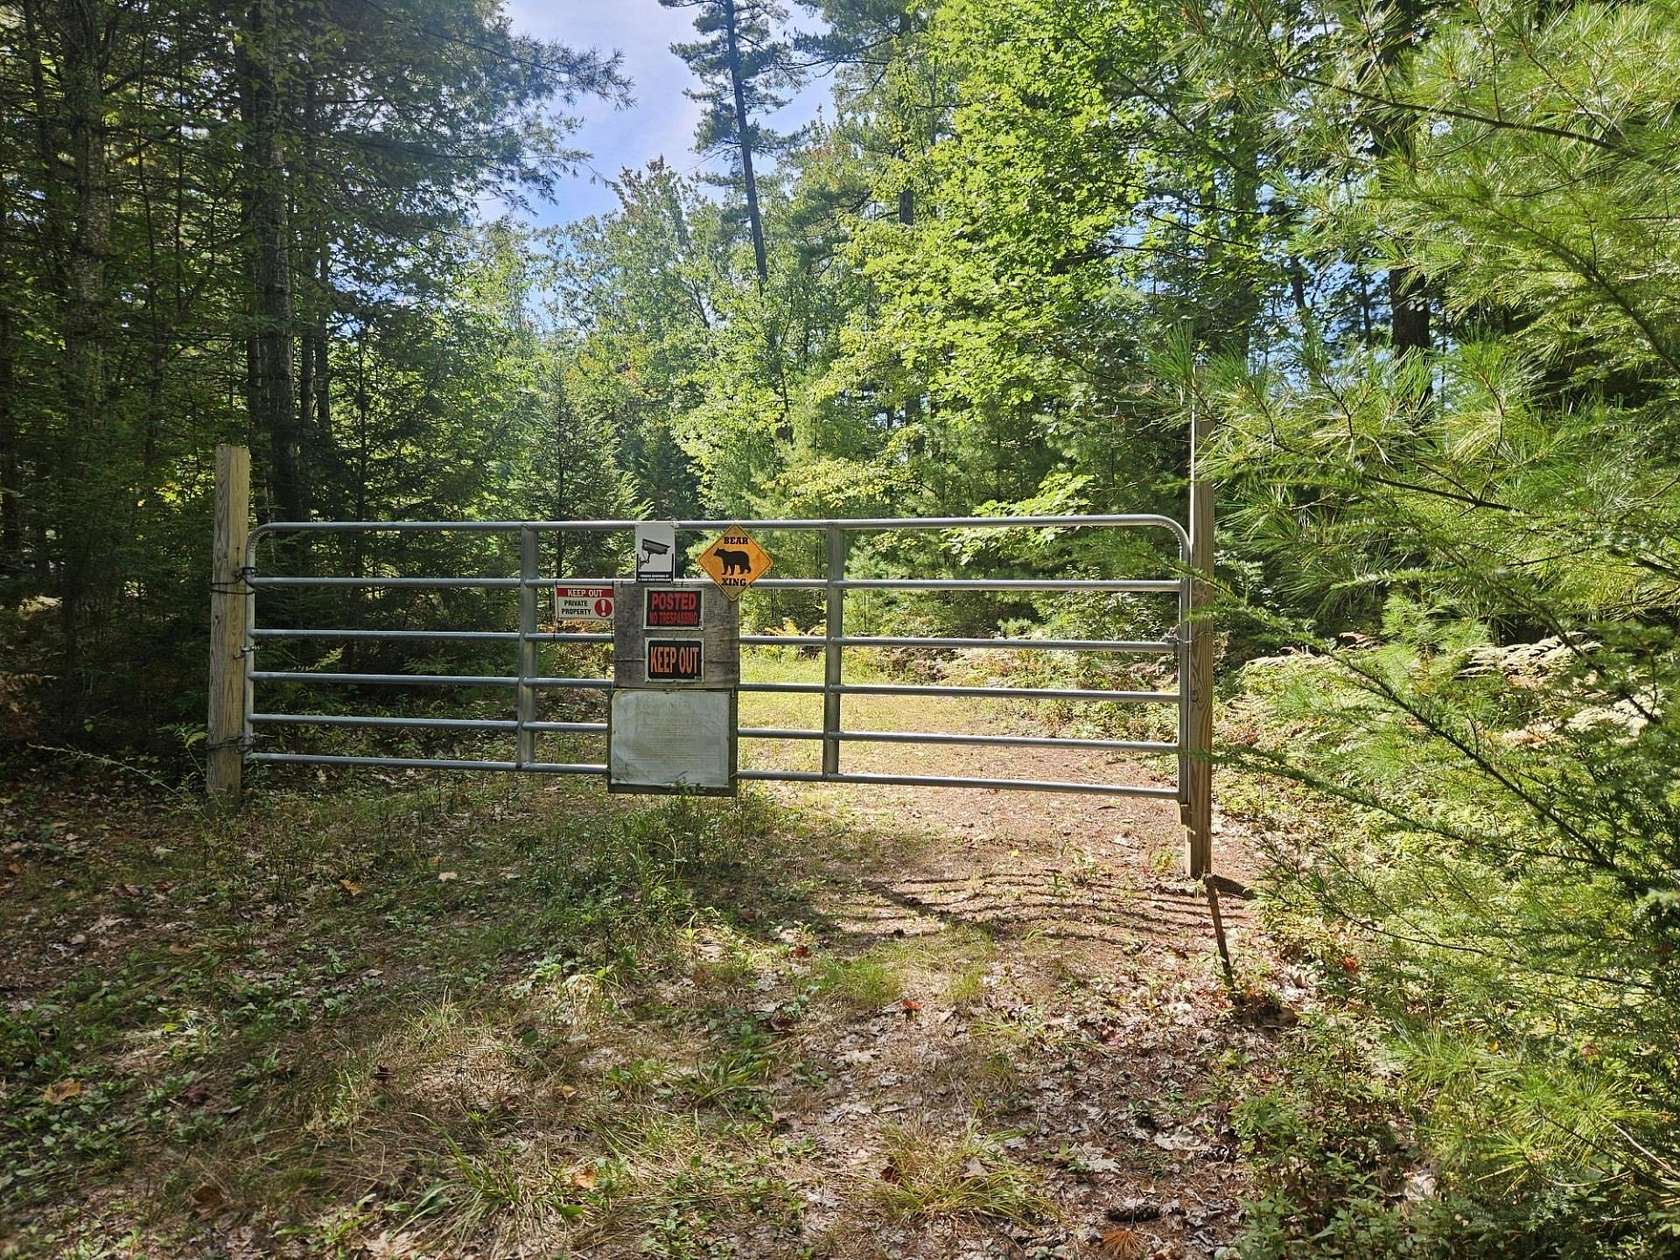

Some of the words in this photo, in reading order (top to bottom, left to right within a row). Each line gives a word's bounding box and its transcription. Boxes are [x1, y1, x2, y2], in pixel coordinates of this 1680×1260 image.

[723, 536, 749, 545] BEAR
[721, 577, 747, 587] XING
[567, 588, 587, 597] KEEP
[588, 588, 603, 597] OUT
[564, 599, 588, 607] PRIVATE
[651, 592, 697, 610] POSTED
[561, 608, 592, 616] PROPERTY
[649, 610, 658, 625] NO
[659, 610, 698, 625] TRESPASSING
[650, 645, 677, 673] KEEP
[678, 645, 700, 674] OUT
